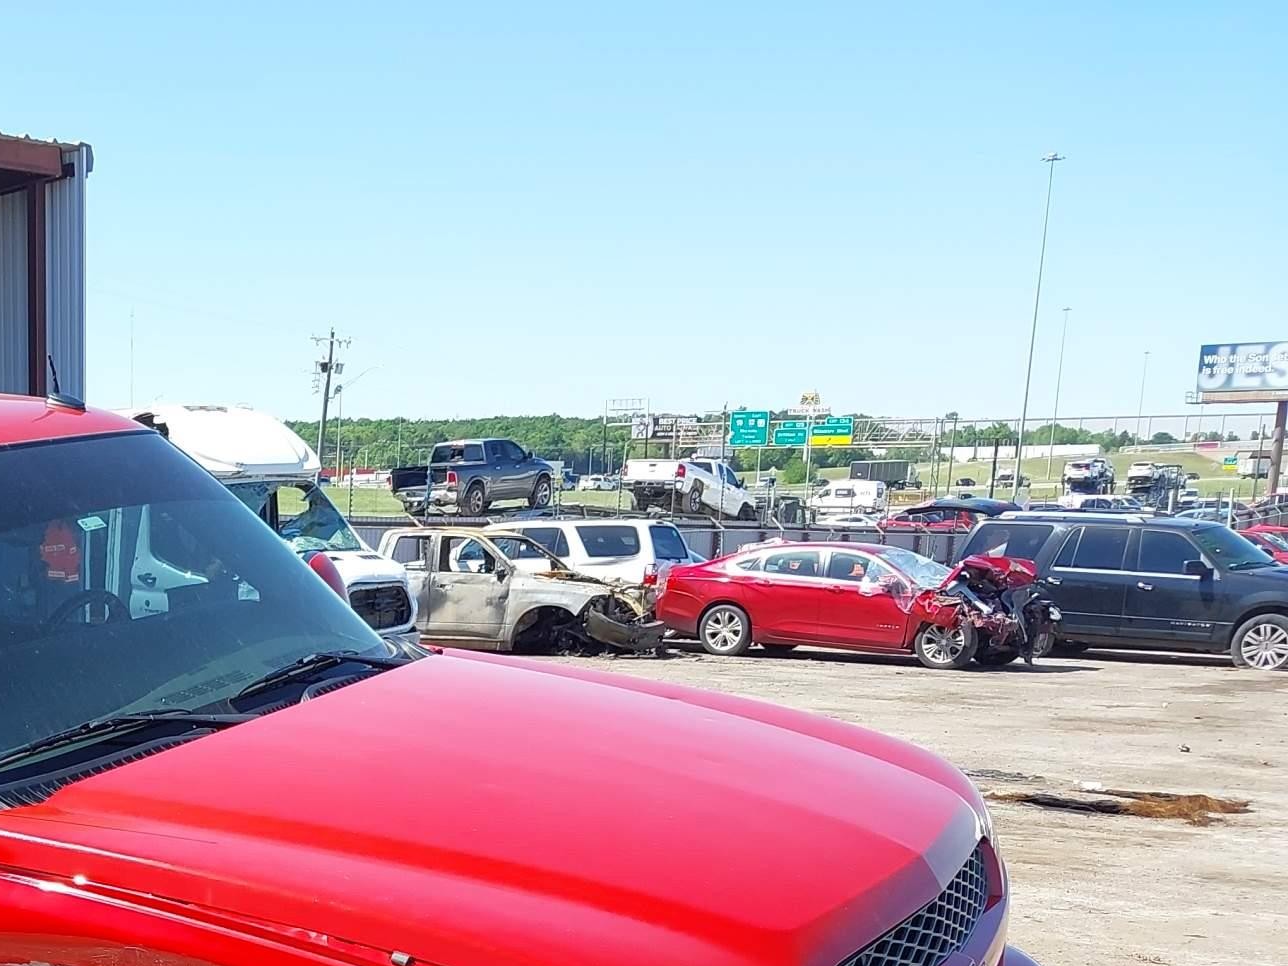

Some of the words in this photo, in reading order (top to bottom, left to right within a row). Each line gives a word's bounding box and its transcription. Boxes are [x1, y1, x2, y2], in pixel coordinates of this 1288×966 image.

[1204, 354, 1227, 365] Who
[1248, 352, 1269, 362] Son
[1202, 365, 1212, 375] is
[1213, 365, 1234, 375] free
[659, 417, 676, 425] BEST
